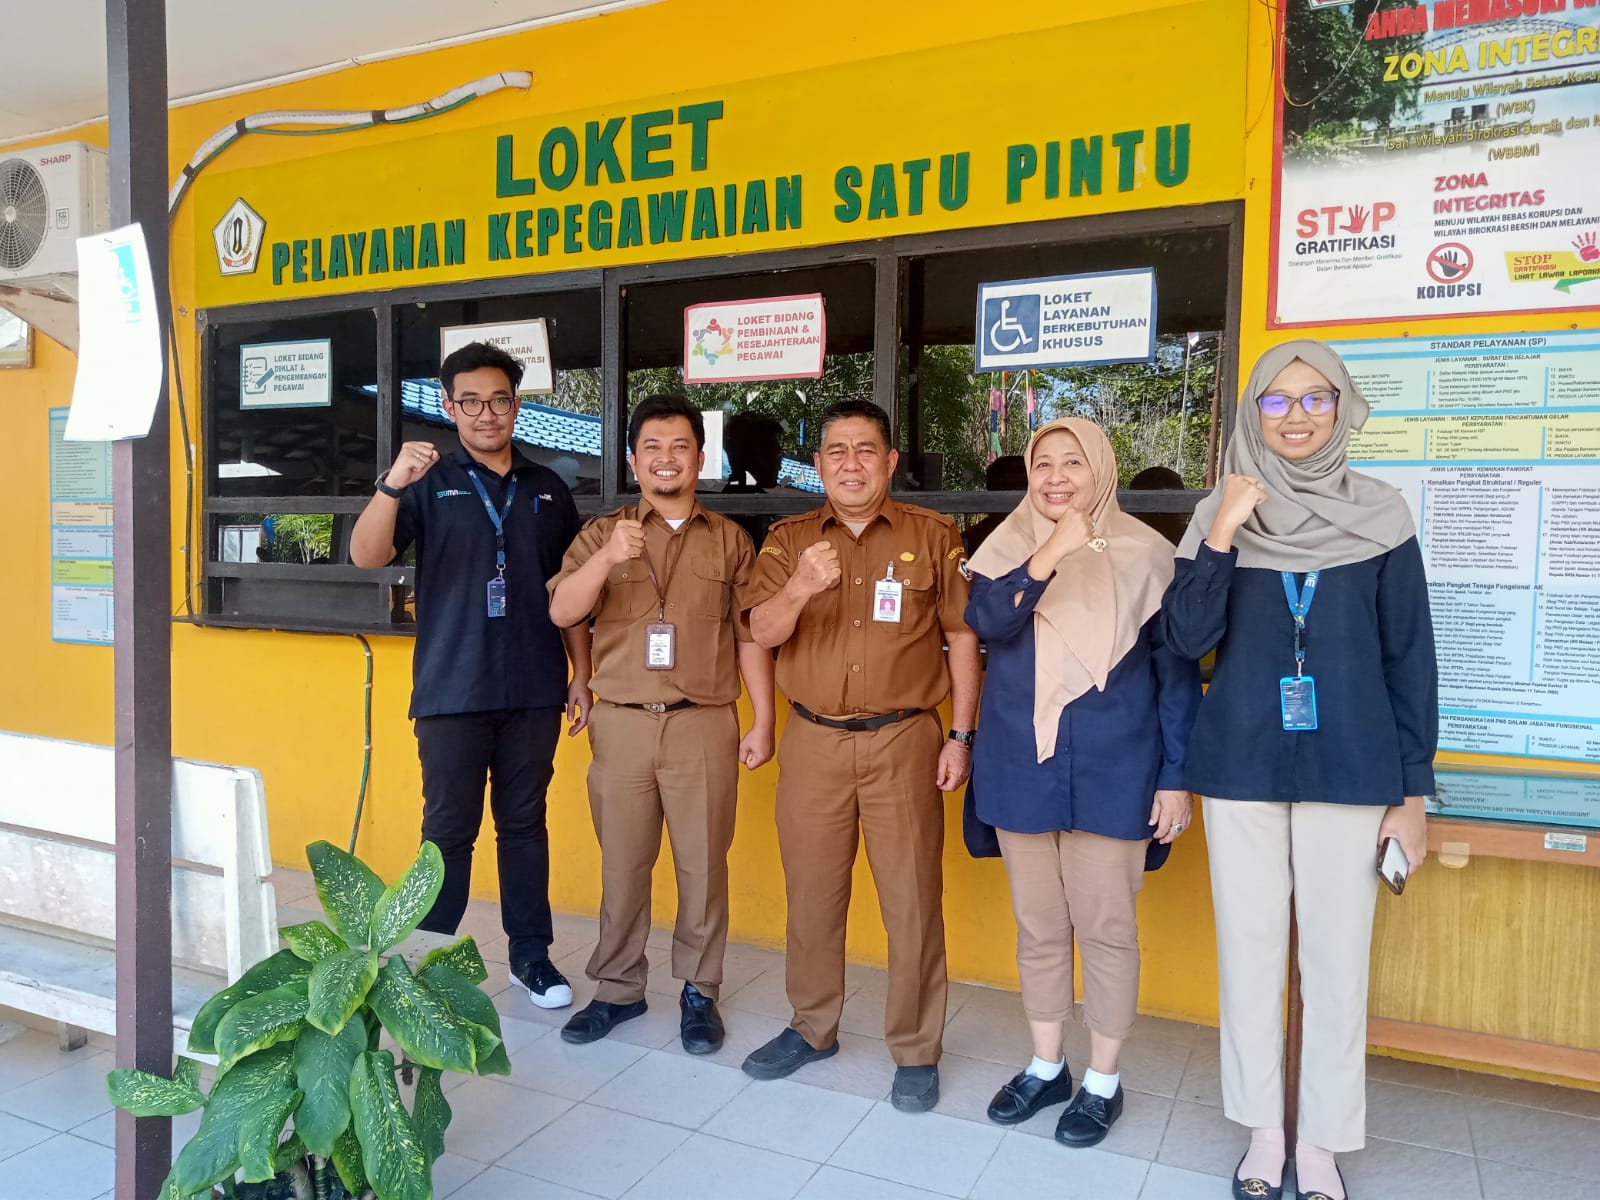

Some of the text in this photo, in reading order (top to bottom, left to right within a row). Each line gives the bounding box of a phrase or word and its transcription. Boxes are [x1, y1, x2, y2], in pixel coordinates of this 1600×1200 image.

[1365, 5, 1428, 40] ANDA
[1383, 26, 1600, 80] ZONA INTEGR
[1424, 85, 1469, 103] Menuju
[1472, 79, 1522, 96] Wilayah
[1525, 73, 1564, 89] Bebas
[1496, 98, 1535, 117] (WBK)
[1387, 139, 1409, 150] Dan
[1416, 132, 1462, 148] Wilayah
[1467, 124, 1520, 142] Birokrasi
[1523, 117, 1562, 134] Bersih
[1566, 115, 1590, 129] dan
[496, 100, 723, 198] LOKET
[1488, 143, 1540, 161] (WBBM)
[40, 154, 72, 166] SHARP
[1434, 172, 1489, 192] ZONA
[272, 123, 1190, 285] PELAYANAN KEPEGAWAIAN SATU PINTU
[1433, 189, 1546, 214] INTEGRITAS
[1434, 207, 1583, 227] MENUJU WILAYAH BEBAS KORUPSI DAN
[1434, 228, 1467, 237] WILAYAH
[1468, 225, 1509, 235] BIROKRASI
[1510, 222, 1538, 231] BERSIH
[1540, 220, 1557, 229] DAN
[1296, 234, 1395, 255] GRATIFIKASI
[1513, 254, 1552, 265] STOP
[1043, 291, 1093, 305] LOKET
[1417, 283, 1482, 299] KORUPSI
[737, 311, 815, 326] LOKET BIDANG
[1043, 305, 1111, 319] LAYANAN
[737, 325, 810, 339] PEMBINAAN &
[1043, 317, 1148, 334] BERKEBUTUHAN
[737, 336, 820, 350] KESEJAHTERAAN
[1042, 335, 1104, 350] KHUSUS
[1430, 338, 1547, 350] STANDAR PELAYANAN (SP)
[274, 352, 324, 363] LOKET BIDANG
[521, 356, 545, 365] UTASI
[737, 349, 784, 361] PEGAWAI
[274, 363, 306, 373] DIKLAT &
[274, 372, 327, 382] PENGEMBANGAN
[274, 382, 305, 392] PEGAWAI
[1457, 479, 1481, 487] Pangkat
[1517, 479, 1542, 487] Reguler
[1472, 582, 1495, 590] Tenaga
